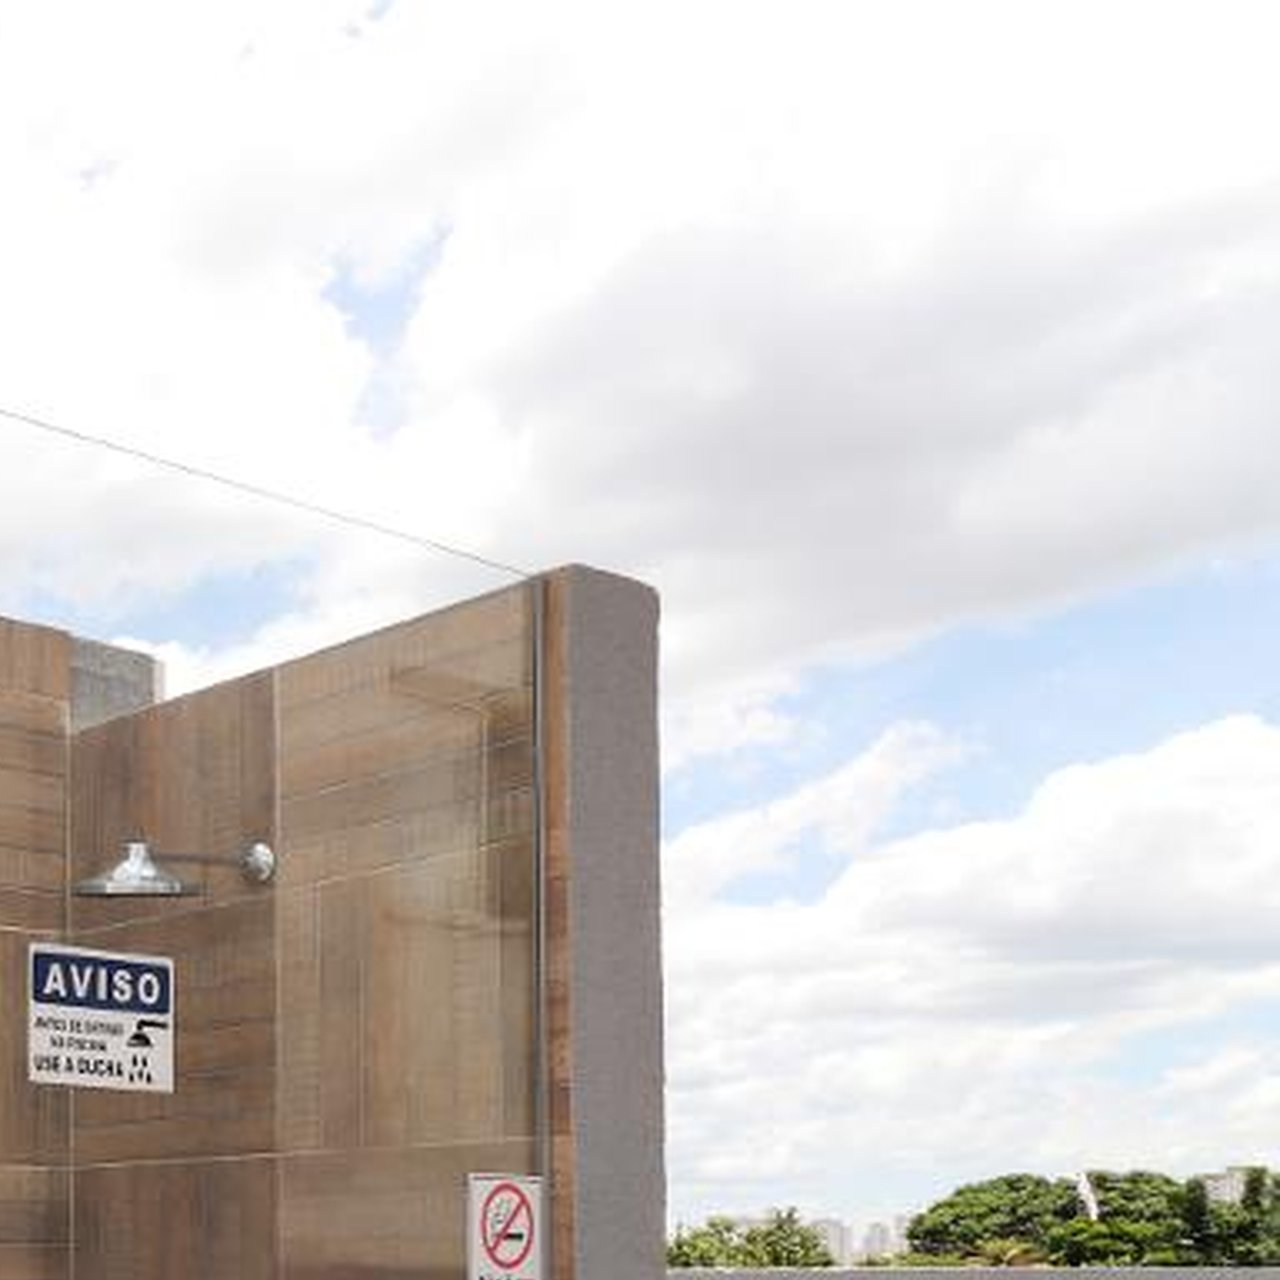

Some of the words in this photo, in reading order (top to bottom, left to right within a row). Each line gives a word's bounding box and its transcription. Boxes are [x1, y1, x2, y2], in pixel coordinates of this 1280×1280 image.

[42, 962, 160, 1004] AVISO
[34, 1055, 60, 1072] USE
[64, 1056, 74, 1072] A
[77, 1057, 124, 1077] DUCHA
